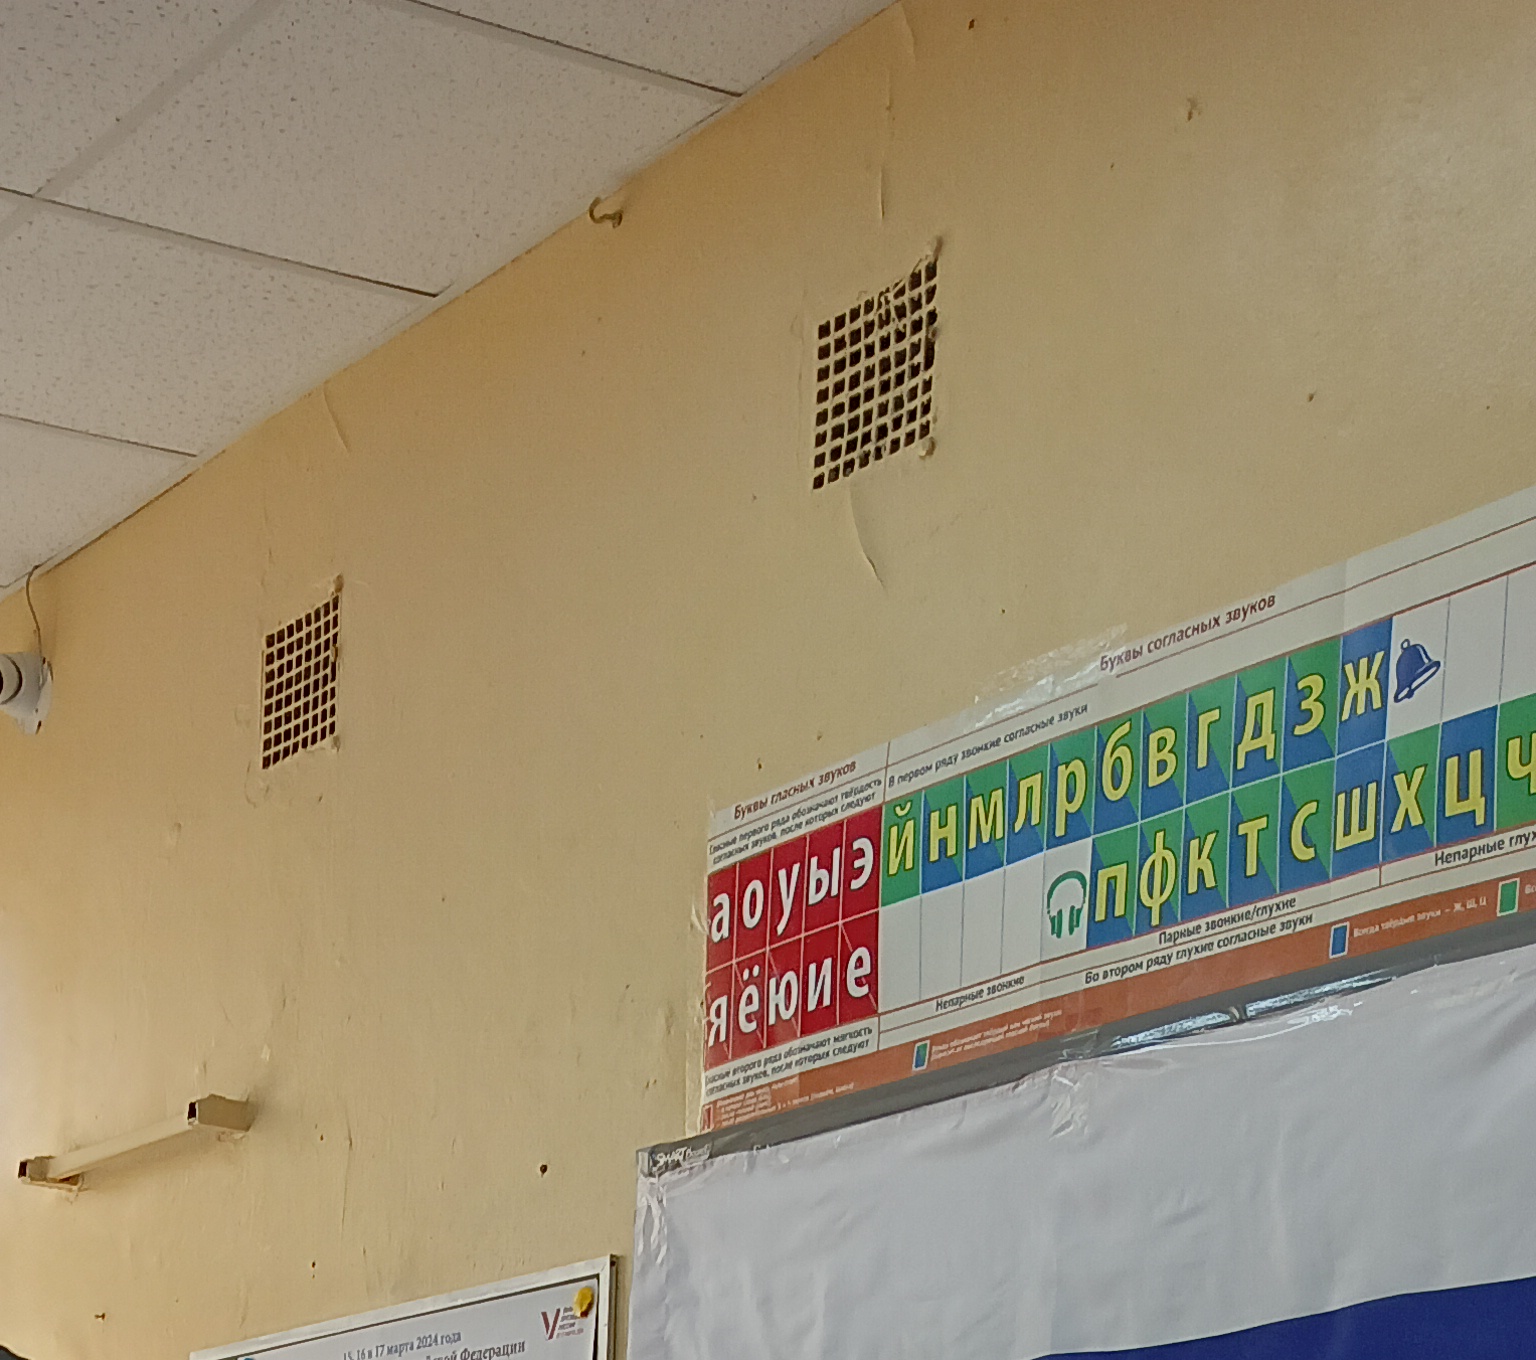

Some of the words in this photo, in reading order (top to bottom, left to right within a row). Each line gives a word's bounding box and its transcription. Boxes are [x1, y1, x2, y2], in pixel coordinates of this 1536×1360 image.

[1099, 644, 1144, 673] Буквы
[1147, 615, 1221, 654] согласных
[1225, 594, 1276, 624] звуков
[887, 775, 896, 788] В
[897, 763, 933, 785] первом
[935, 752, 959, 773] ряду
[961, 736, 1002, 760] звонкие
[1003, 715, 1055, 743] согласные
[1057, 703, 1089, 723] звуки
[734, 797, 768, 821] Буквы
[770, 777, 815, 806] гласных
[818, 760, 857, 786] звуков
[1434, 836, 1506, 867] Непарные
[1102, 959, 1144, 981] втором
[1146, 950, 1174, 972] ряду
[1175, 940, 1215, 962] глухие
[1216, 922, 1277, 950] согласные
[1279, 913, 1314, 935] звуки
[1158, 922, 1202, 946] Парные
[1204, 896, 1297, 934] звонкие/глухие
[935, 987, 985, 1012] Непарные
[375, 1344, 386, 1359] 17
[386, 1341, 415, 1359] марта
[416, 1332, 439, 1351] 2024
[440, 1331, 462, 1347] года
